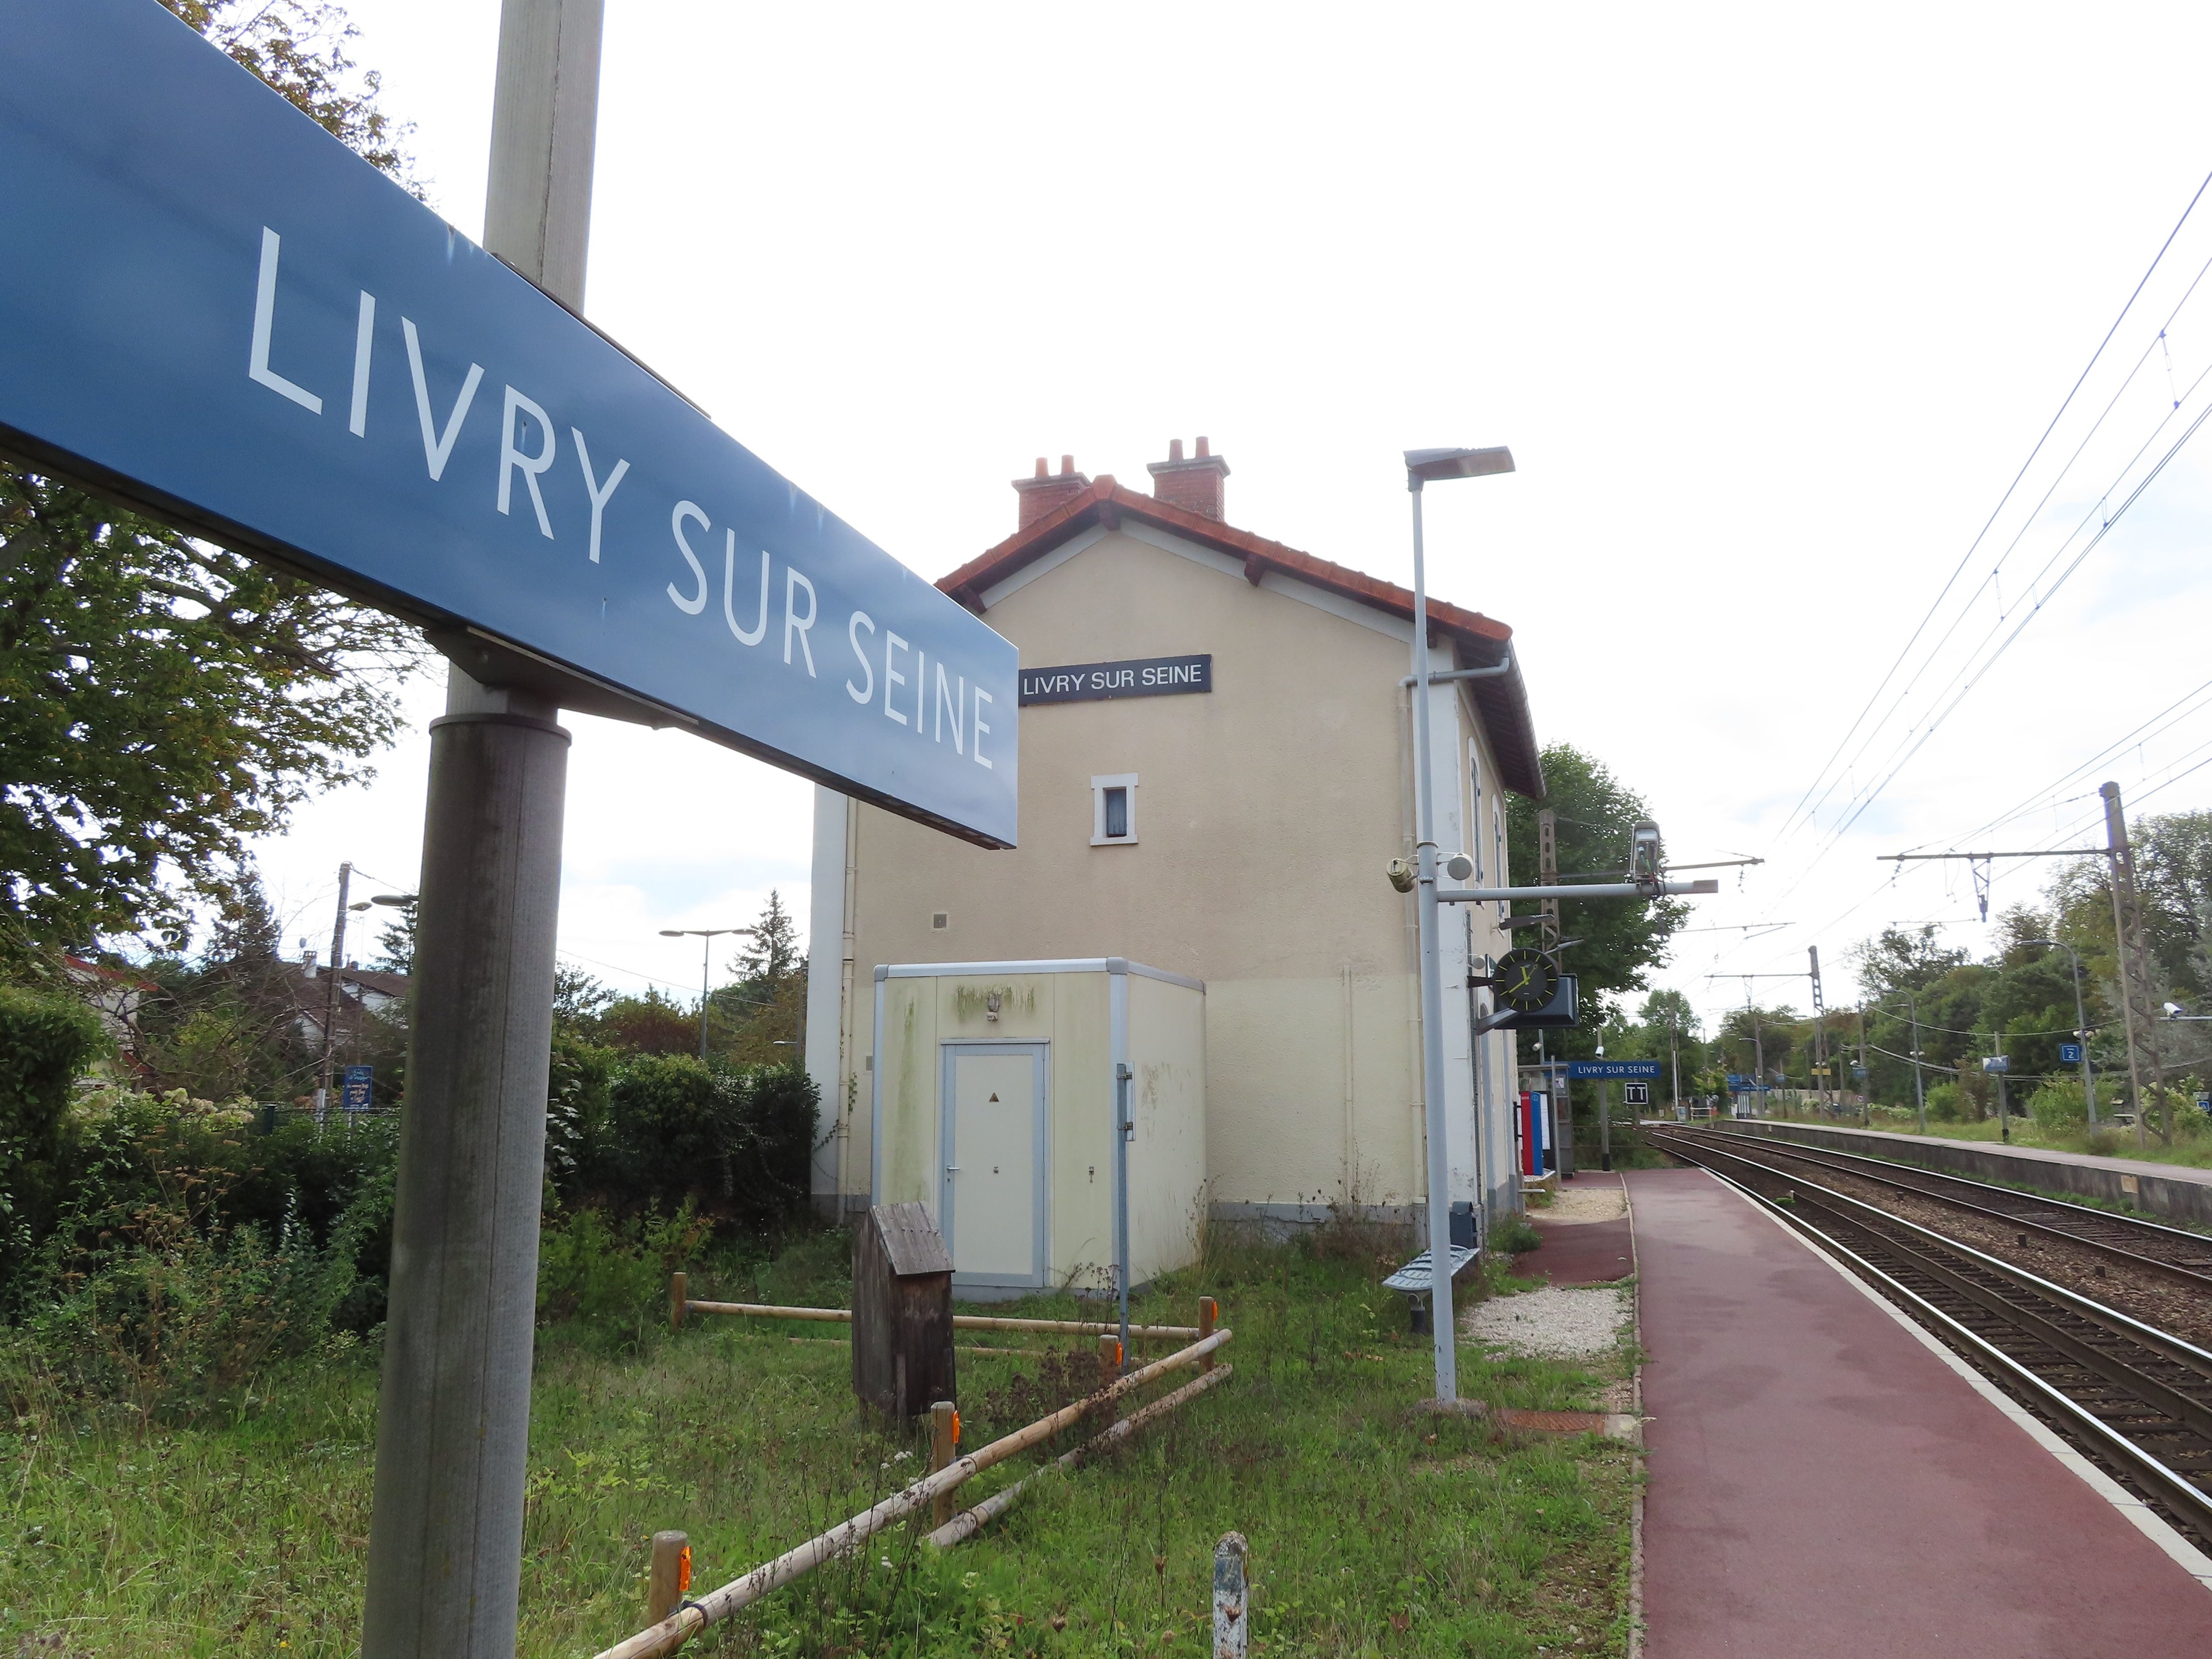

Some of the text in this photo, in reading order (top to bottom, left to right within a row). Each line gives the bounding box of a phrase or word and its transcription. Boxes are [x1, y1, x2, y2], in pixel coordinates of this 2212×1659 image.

[249, 226, 993, 770] LIVRY SUR SEINE
[1024, 664, 1202, 695] LIVRY SUR SEINE
